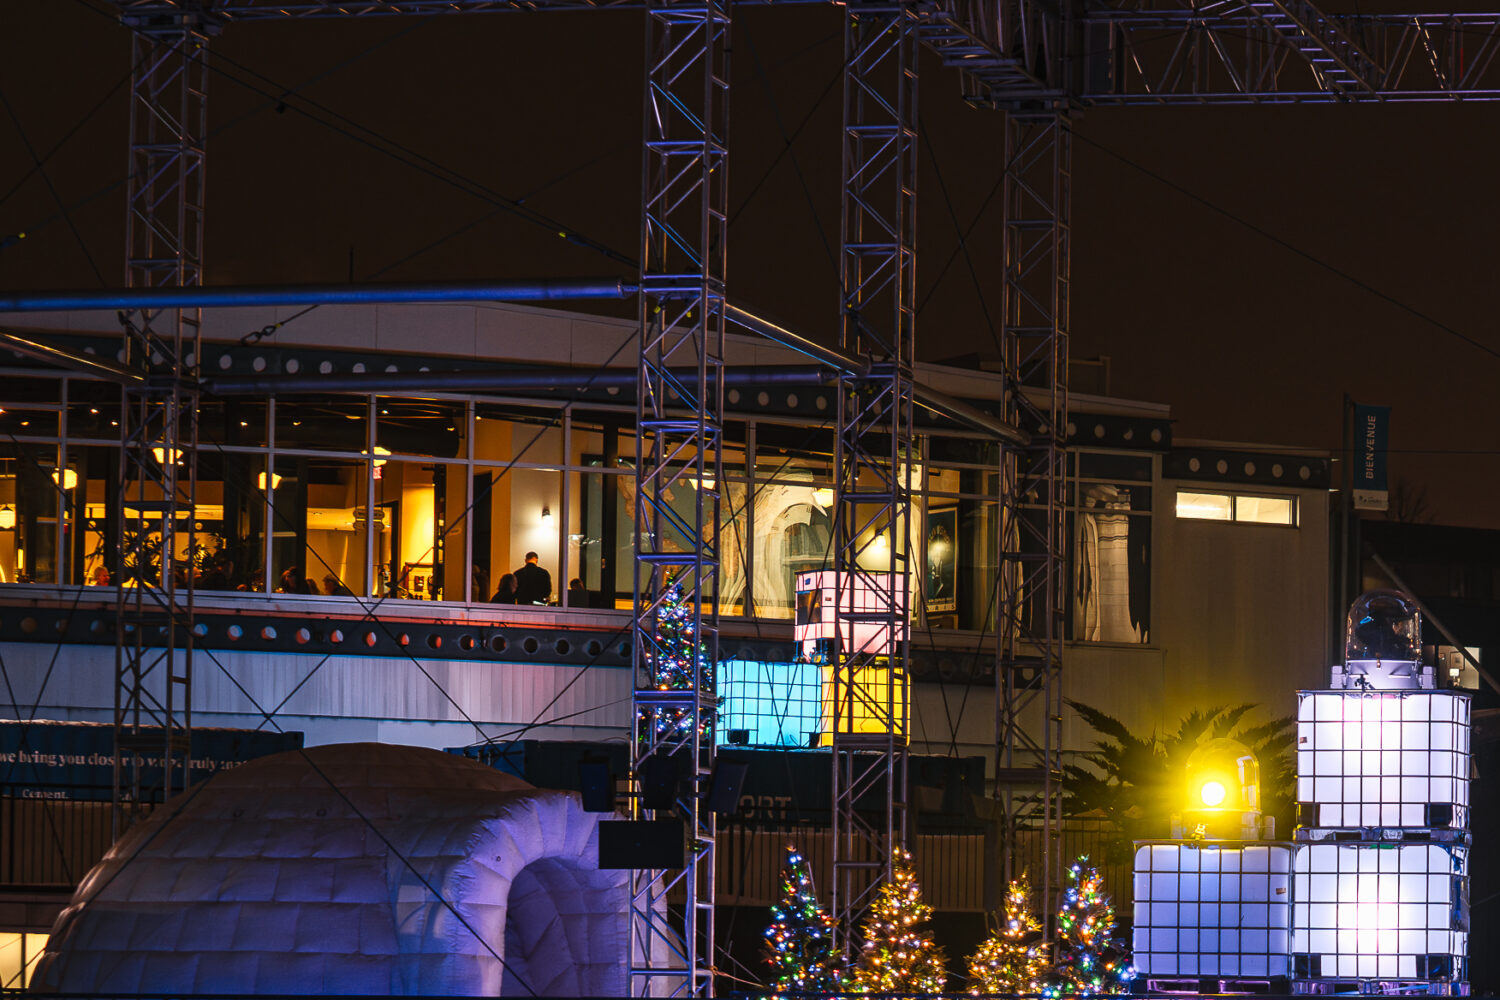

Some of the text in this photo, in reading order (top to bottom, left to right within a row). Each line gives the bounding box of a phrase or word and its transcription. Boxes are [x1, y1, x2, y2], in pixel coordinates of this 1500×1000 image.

[1365, 415, 1377, 479] BIENVENUE
[18, 750, 57, 767] bring
[58, 753, 86, 767] you
[87, 752, 130, 767] closr
